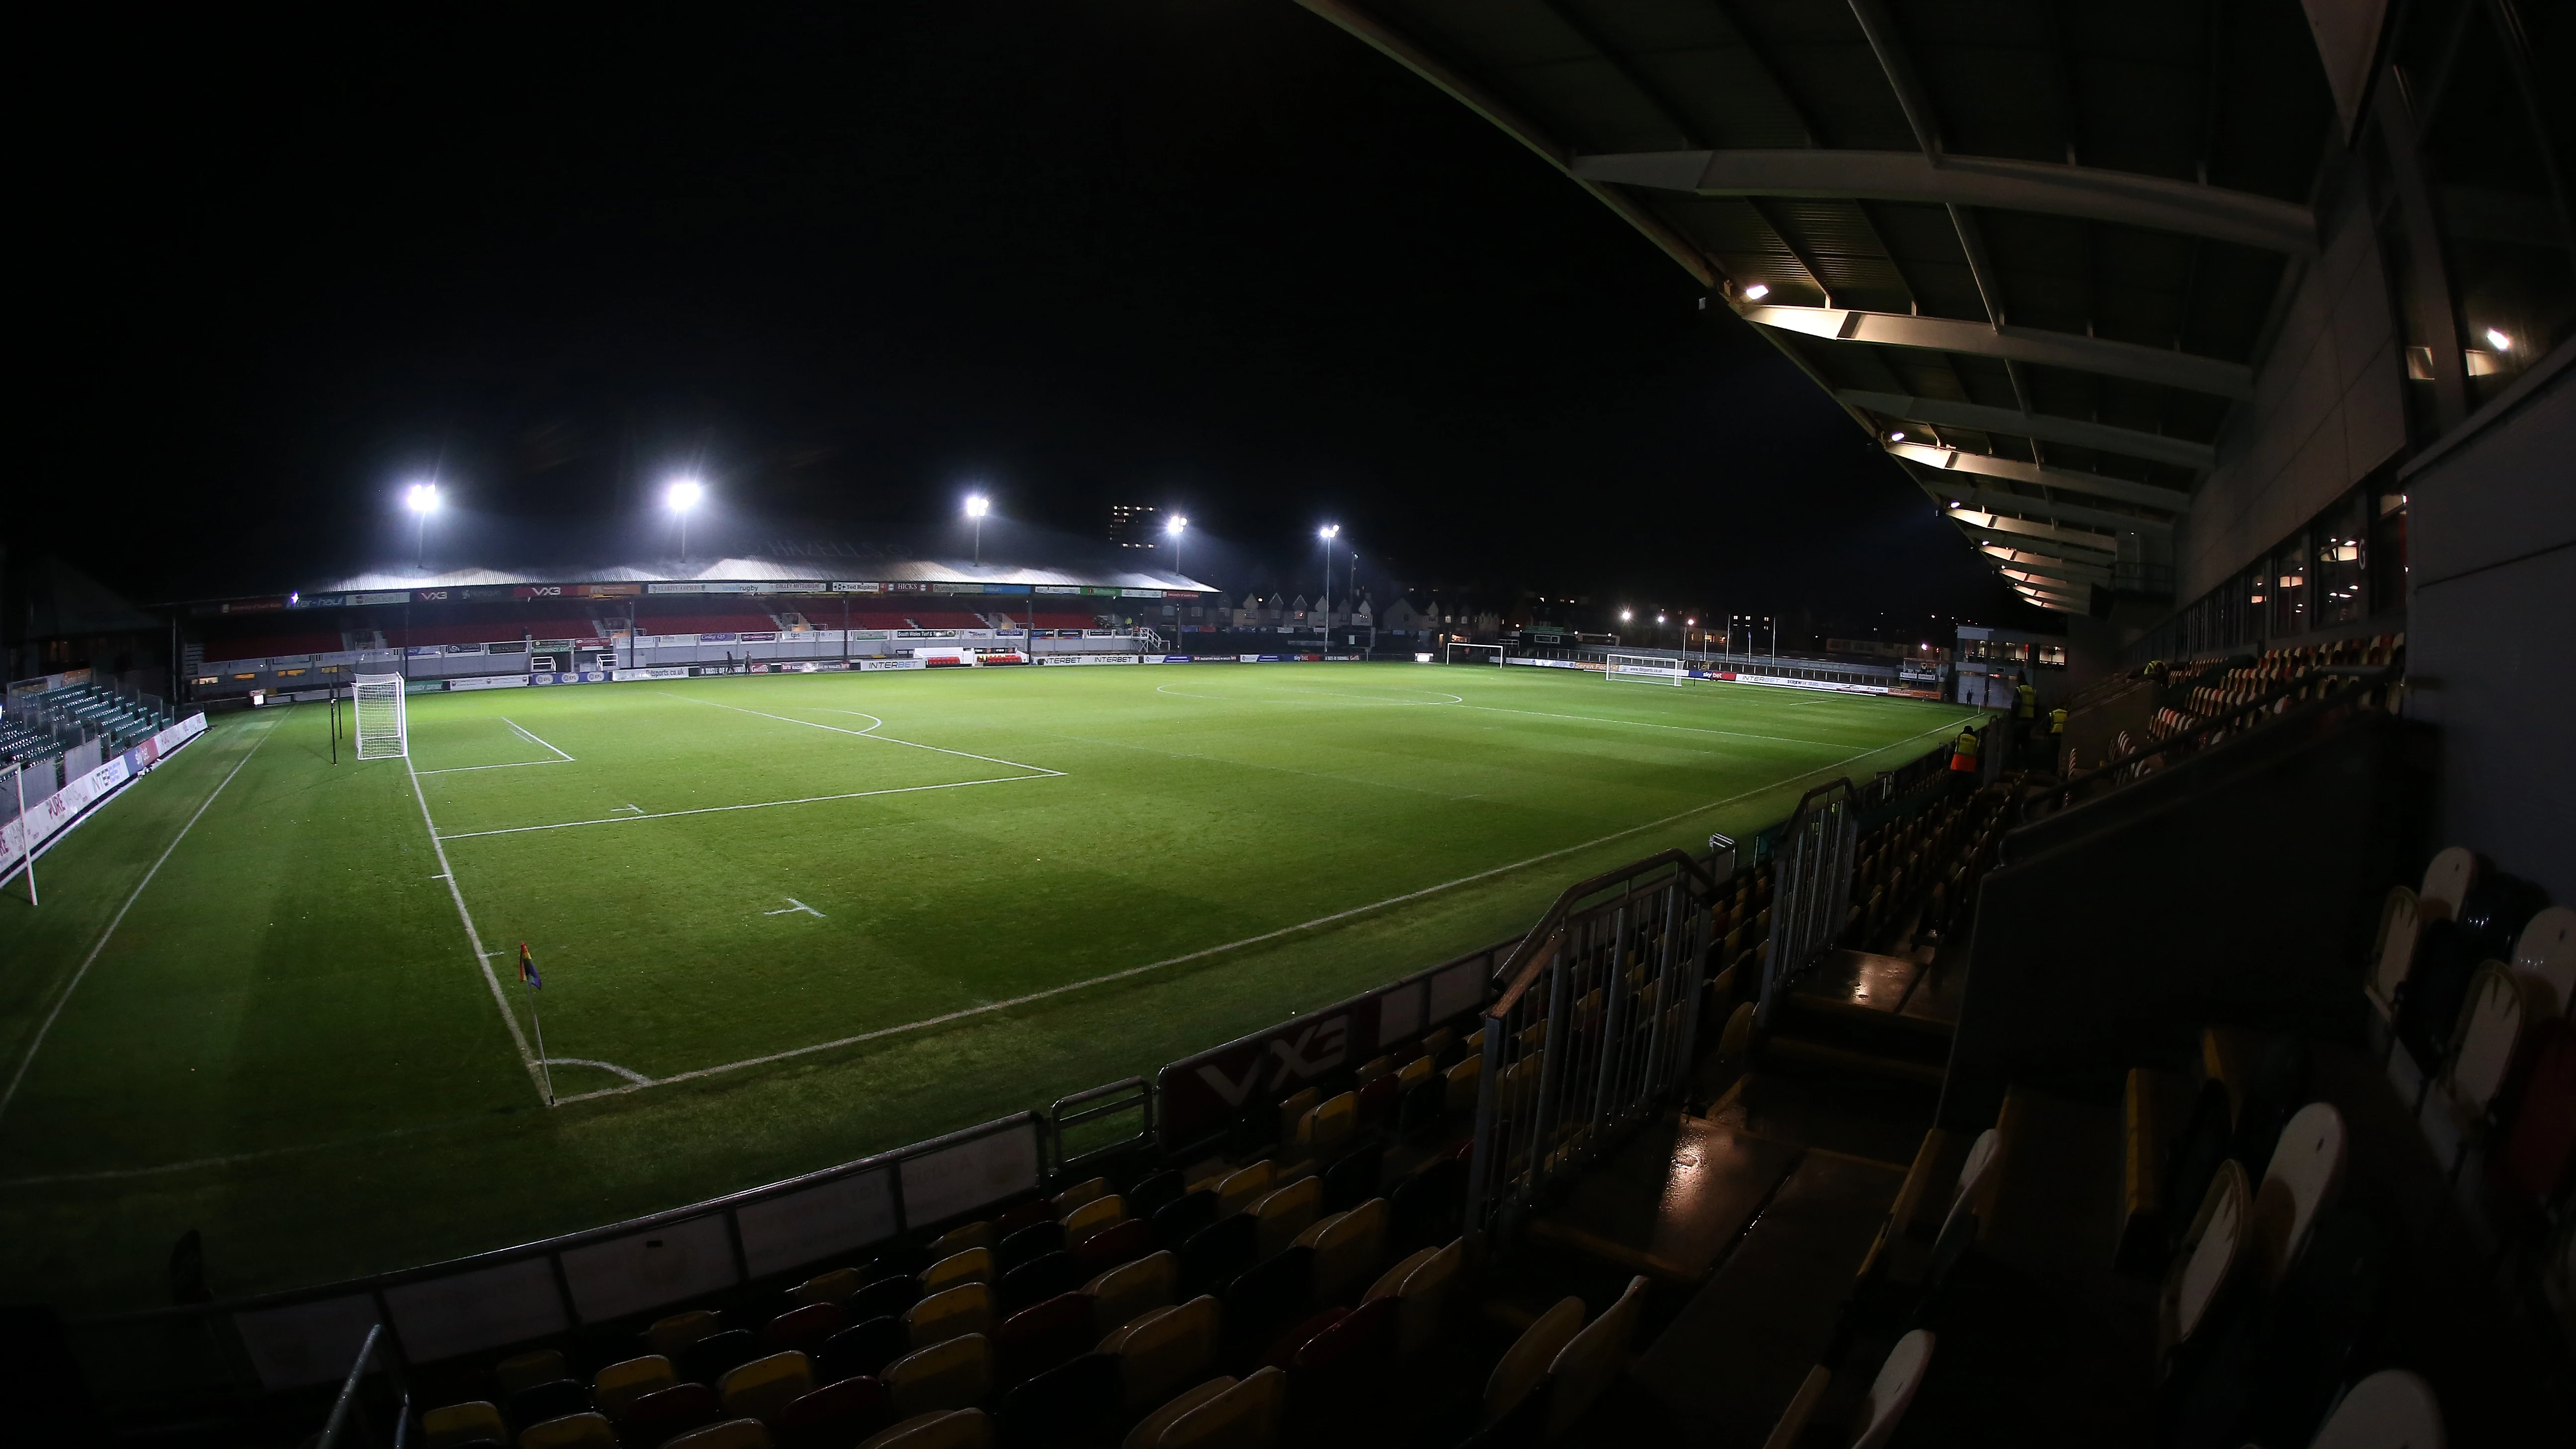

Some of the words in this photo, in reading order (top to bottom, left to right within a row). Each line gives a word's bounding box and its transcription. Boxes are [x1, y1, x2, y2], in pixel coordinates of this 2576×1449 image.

[421, 590, 448, 600] VX3
[532, 586, 562, 596] VX3
[46, 794, 66, 819] PURE
[1194, 1014, 1350, 1107] VX3
